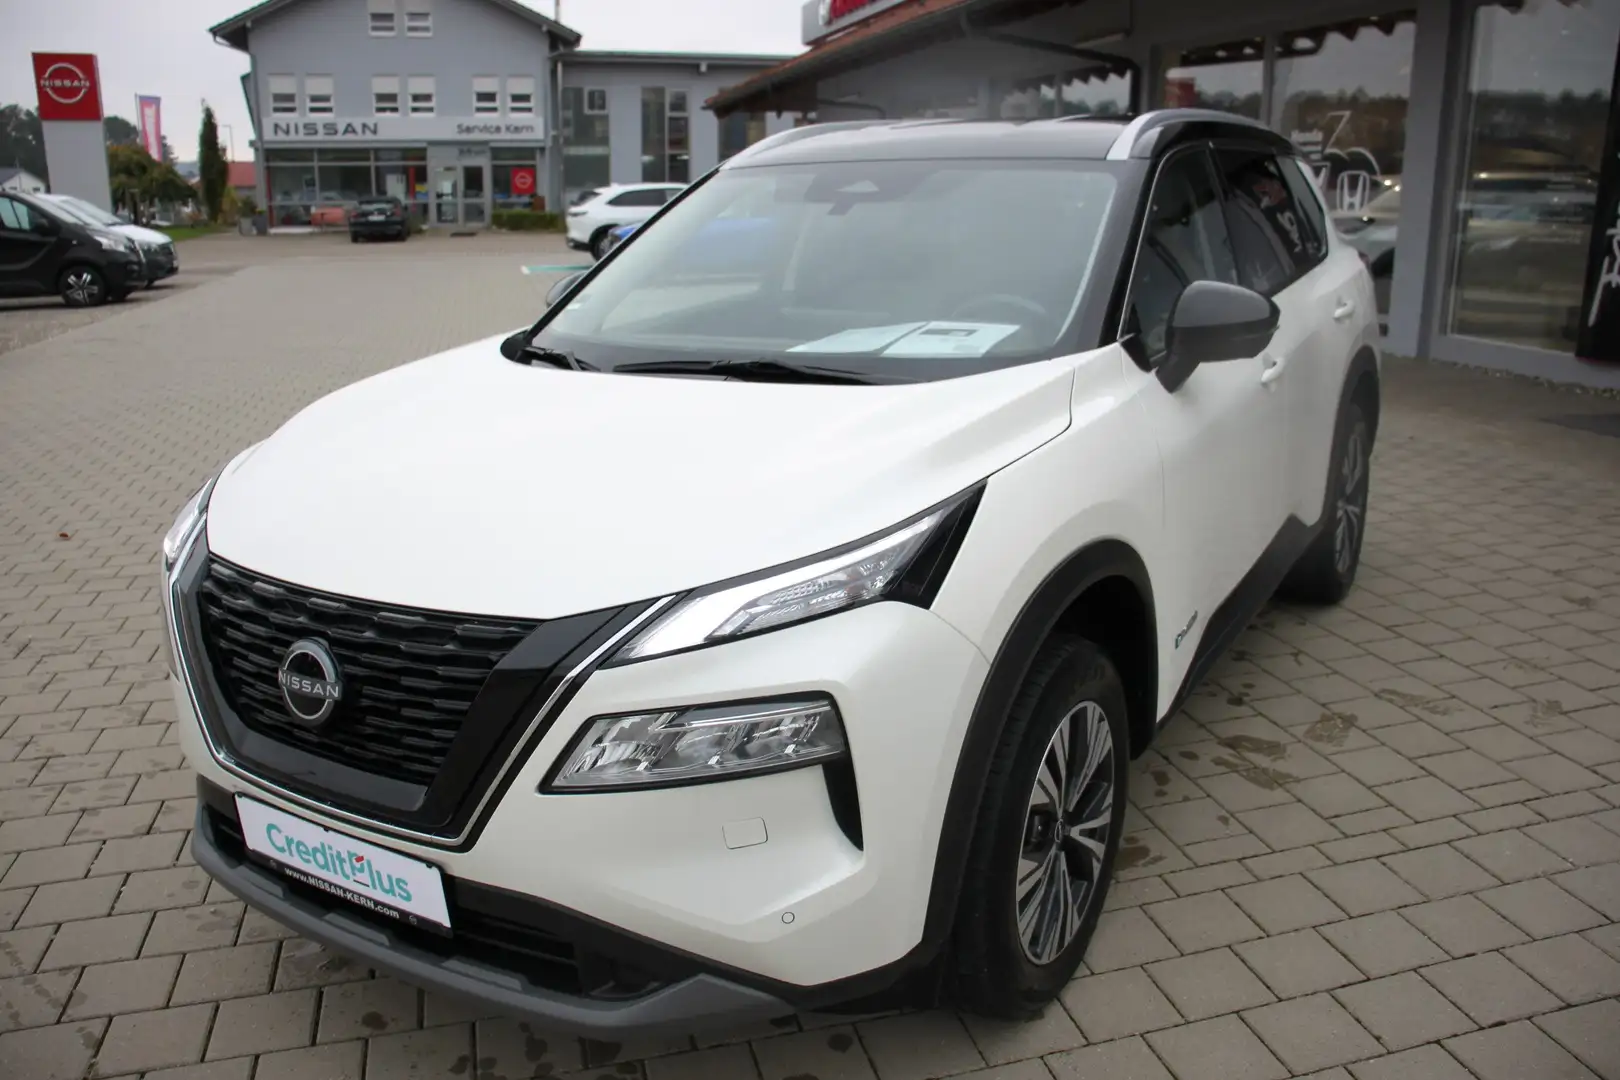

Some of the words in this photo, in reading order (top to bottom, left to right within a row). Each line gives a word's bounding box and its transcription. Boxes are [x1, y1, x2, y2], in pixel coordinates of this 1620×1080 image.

[40, 79, 90, 88] NISSAN
[274, 122, 379, 136] NISSAN
[456, 123, 502, 134] Service
[505, 123, 535, 134] Kern
[278, 671, 340, 699] NISSAN
[284, 866, 400, 919] www.NISSAN-KERN.com
